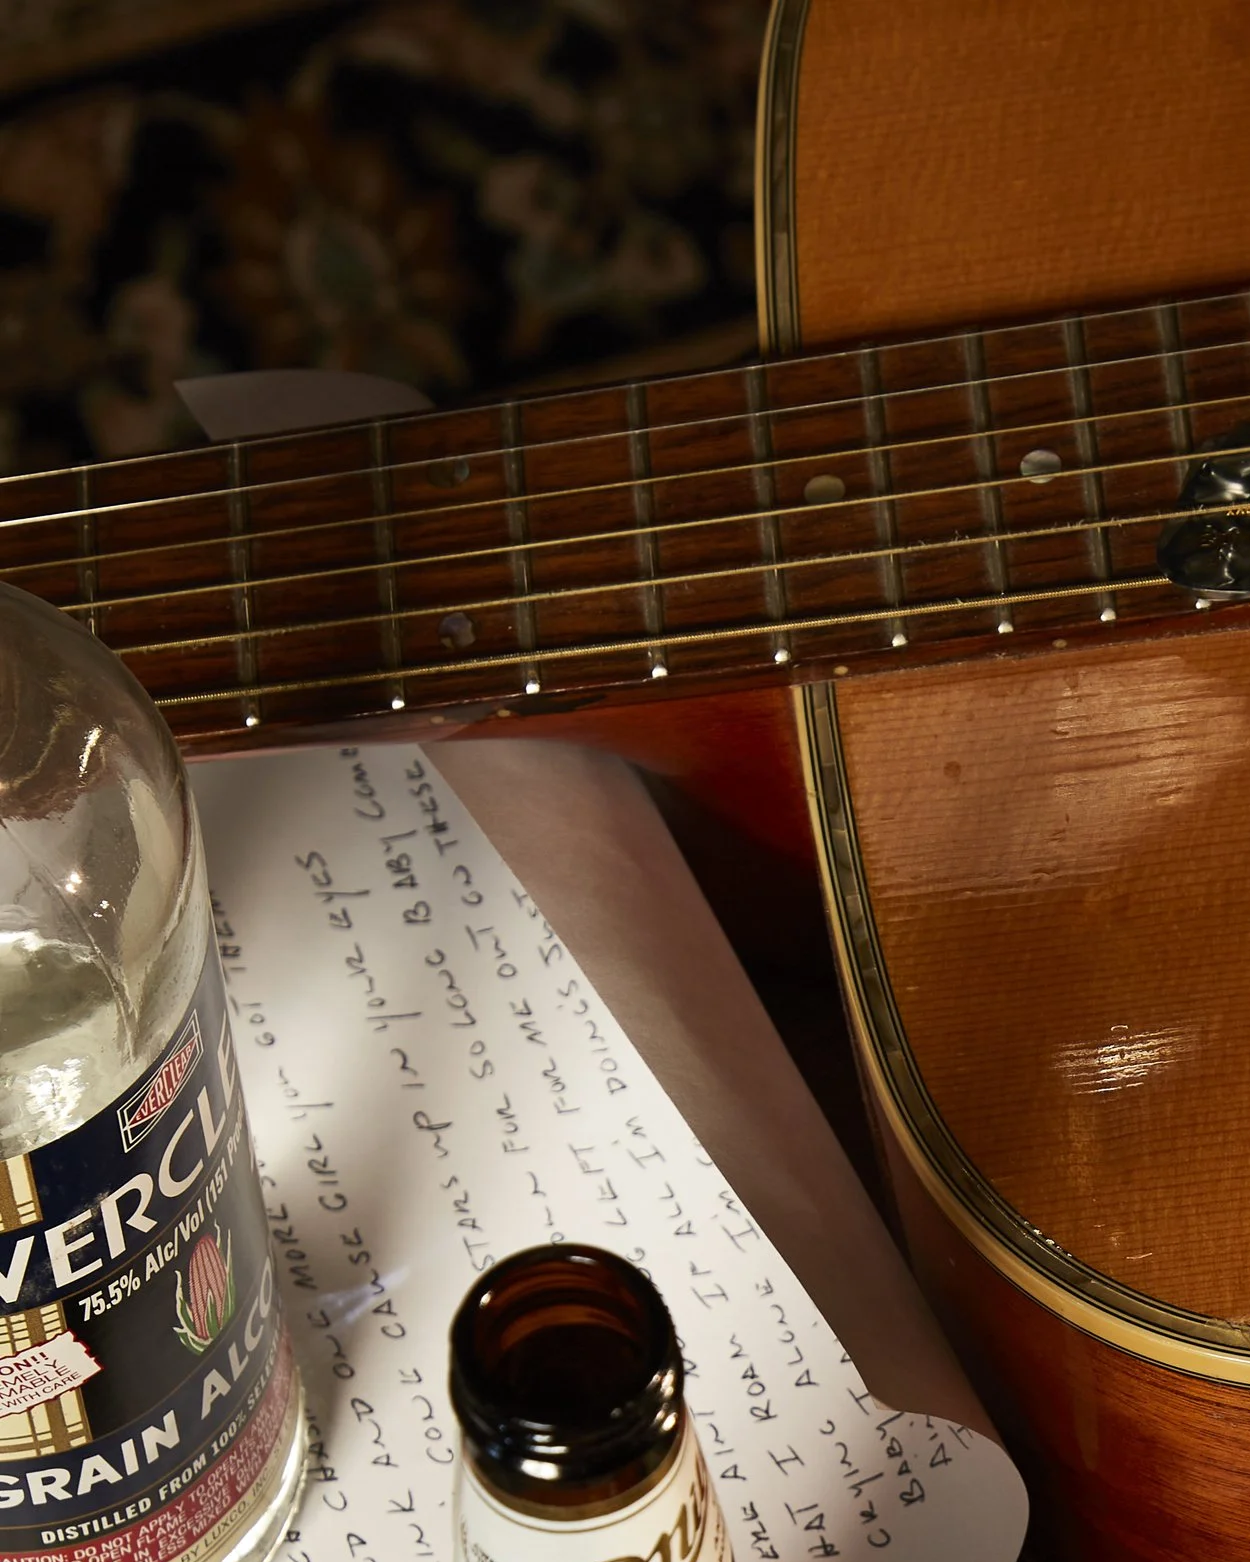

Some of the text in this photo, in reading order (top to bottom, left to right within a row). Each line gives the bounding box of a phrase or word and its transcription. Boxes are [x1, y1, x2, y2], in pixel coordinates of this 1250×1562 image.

[380, 828, 433, 926] BABY
[403, 758, 628, 1227] LEFT FOR ME OUT ON THESE
[423, 947, 476, 1027] LONG
[135, 1043, 194, 1121] EVERCLEAR
[294, 849, 495, 1272] STARS UP IN YOUR EYES
[469, 1040, 495, 1079] SO
[495, 1093, 529, 1154] FOR
[610, 1115, 667, 1168] I'M
[79, 1157, 228, 1322] 75.5% Alc/Vol (151
[231, 997, 455, 1464] GONE CAUSE GIRL YOU GOT
[657, 1181, 698, 1237] ALL
[268, 1204, 321, 1292] MORE
[688, 1259, 729, 1310] IF
[2, 1360, 57, 1387] MELY
[308, 1309, 355, 1380] ONE
[710, 1189, 893, 1548] CRYING ALONE I'M
[729, 1333, 778, 1422] ROAM
[2, 1372, 81, 1408] WITH CARE
[352, 1399, 398, 1467] AND
[767, 1444, 805, 1476] I
[874, 1411, 926, 1506] BABY
[41, 1498, 151, 1545] DISTILLED
[159, 1456, 206, 1500] FROM
[75, 1545, 96, 1559] DO
[101, 1532, 133, 1552] NOT
[139, 1502, 185, 1537] APPLY
[134, 1549, 149, 1562] IN
